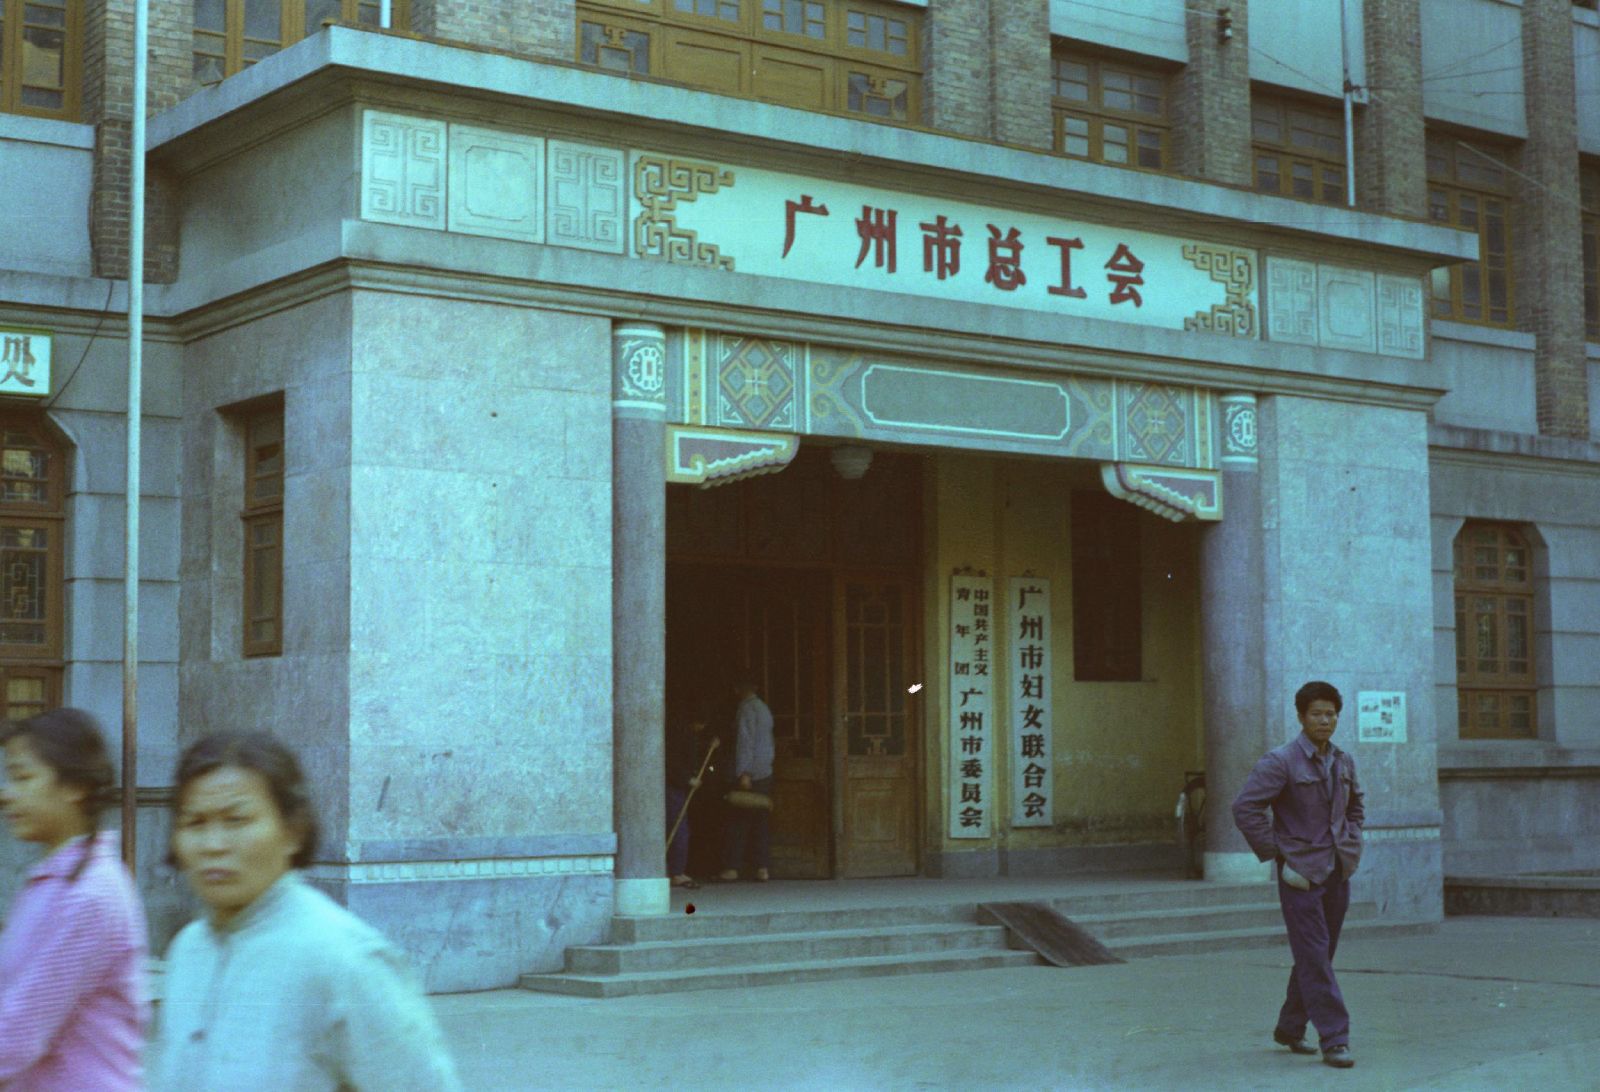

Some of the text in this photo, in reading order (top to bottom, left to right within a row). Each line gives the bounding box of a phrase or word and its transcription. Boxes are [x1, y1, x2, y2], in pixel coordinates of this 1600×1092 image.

[781, 194, 1145, 308] 广州市总工会
[955, 587, 970, 676] 青年团
[974, 588, 989, 676] 中国共产主义
[960, 688, 983, 828] 广州市委员会
[1019, 585, 1047, 818] 广州市妇女联合会
